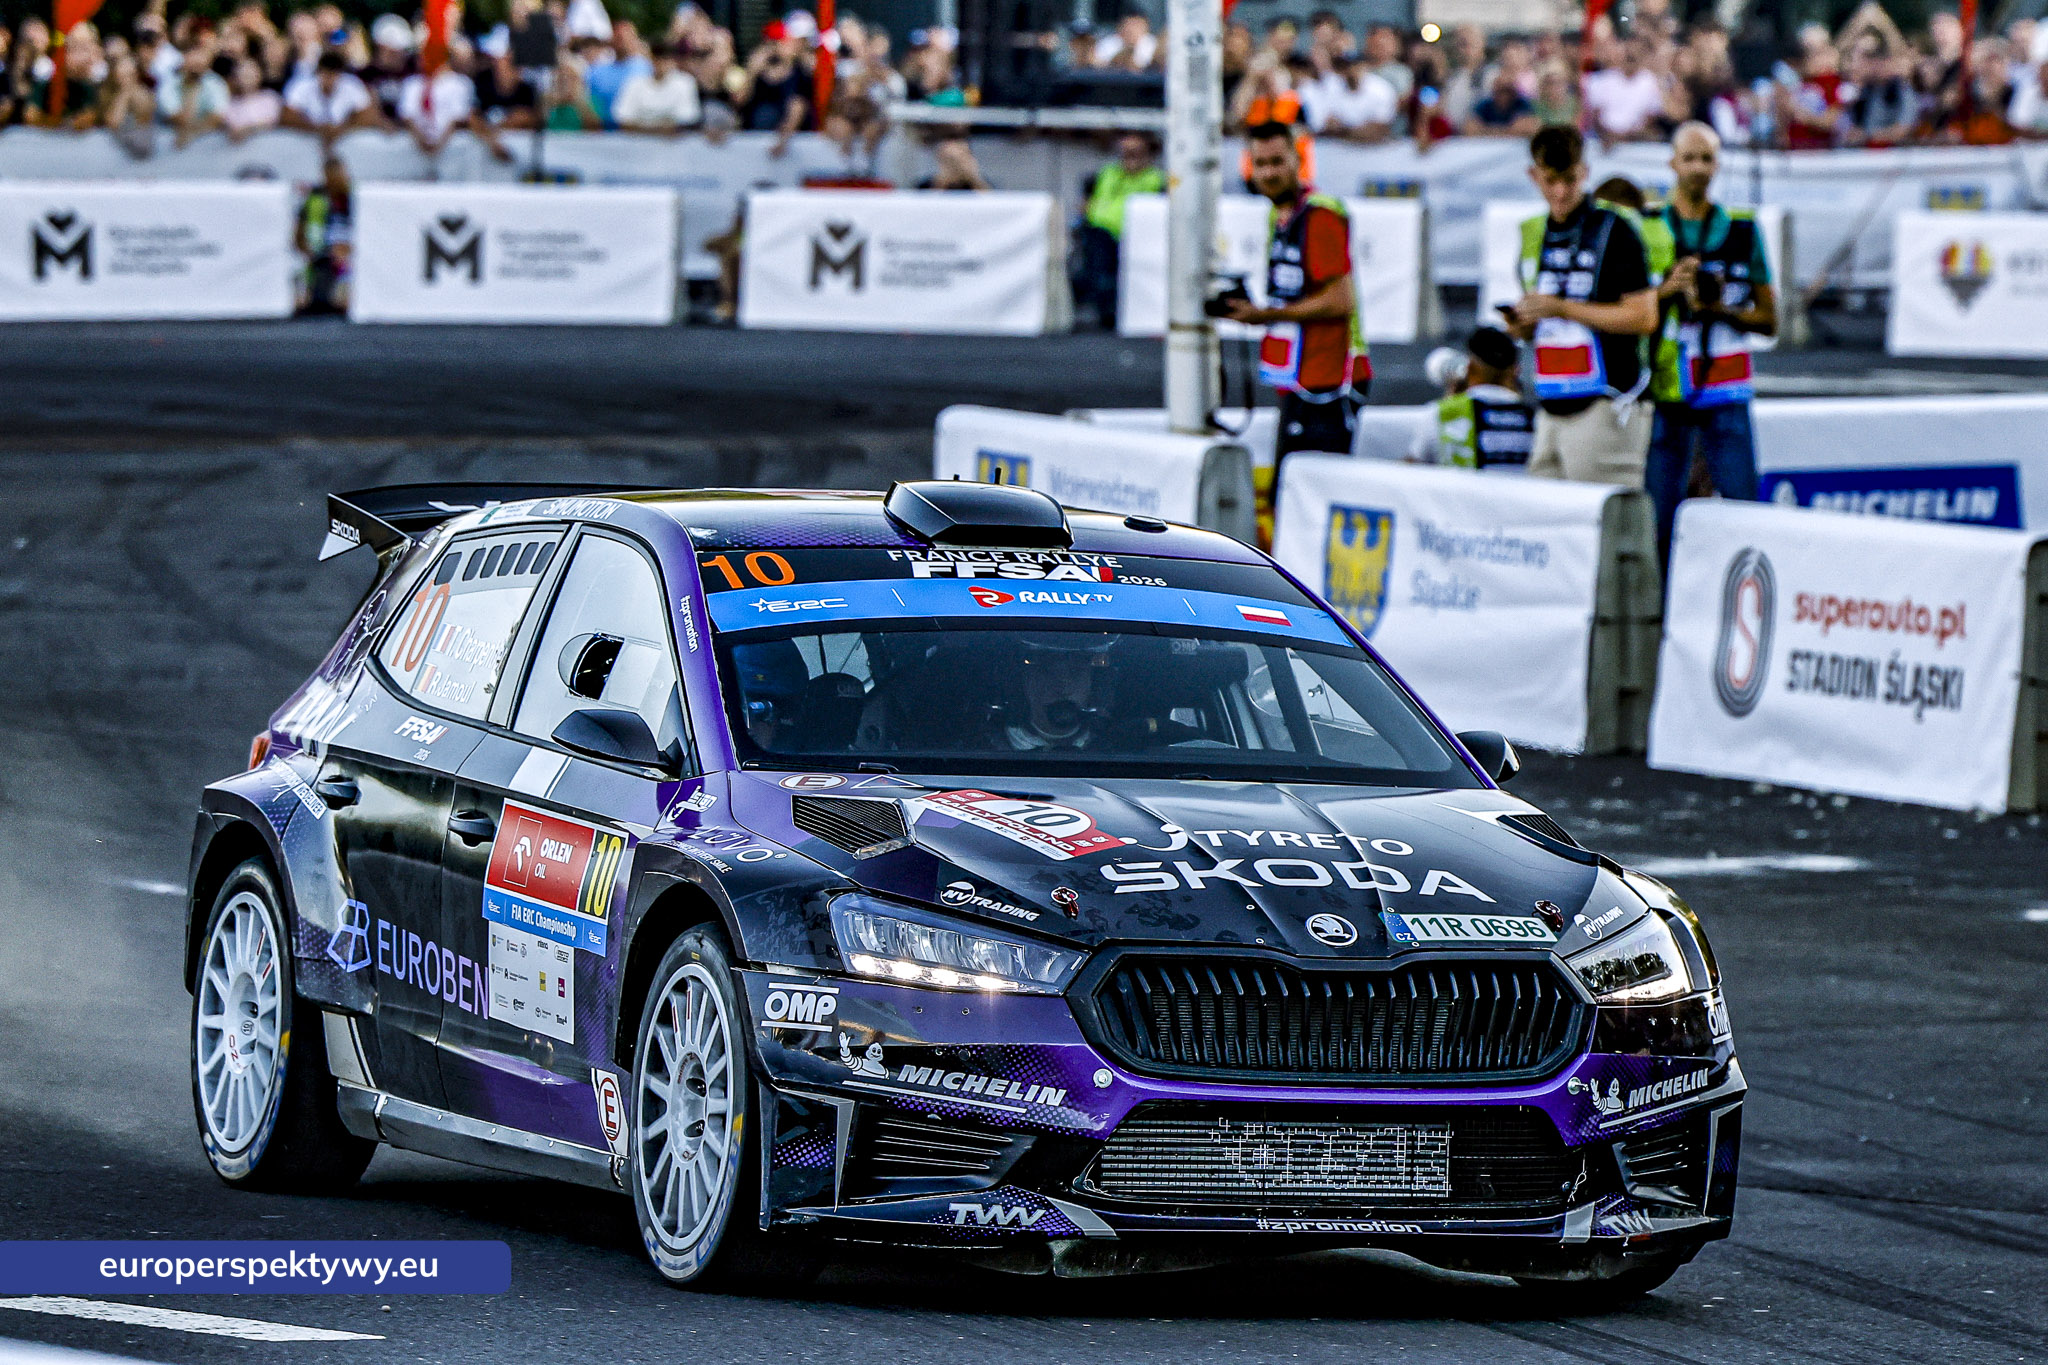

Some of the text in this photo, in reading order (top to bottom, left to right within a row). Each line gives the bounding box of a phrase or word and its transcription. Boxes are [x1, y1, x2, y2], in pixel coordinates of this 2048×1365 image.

[543, 499, 622, 519] SIMUMOTION
[701, 551, 795, 589] 10
[887, 550, 1122, 568] FRANCE RALLYE
[911, 561, 1168, 587] FFSA 2026
[392, 579, 450, 672] 10
[680, 594, 698, 654] #zpromotion
[1794, 591, 1966, 649] superauto.pl
[1786, 648, 1965, 722] STADION ŚLĄSKI
[394, 715, 447, 745] FFSA
[932, 797, 1002, 821] RALLY
[999, 817, 1077, 851] POLAND
[1001, 804, 1081, 827] 10
[540, 838, 574, 864] ORLEN
[1194, 829, 1414, 856] TYRETO
[534, 862, 547, 879] OIL
[585, 834, 622, 917] 10
[511, 903, 577, 941] FIA ERC Championship
[970, 896, 1040, 921] TRADING
[1396, 932, 1414, 941] CZ
[1411, 917, 1547, 938] 11R 0696
[378, 918, 488, 1020] EUROBEN
[764, 990, 837, 1024] OMP
[896, 1064, 1067, 1107] MICHELIN
[1629, 1068, 1709, 1109] MICHELIN
[1256, 1218, 1423, 1235] #zpromotion
